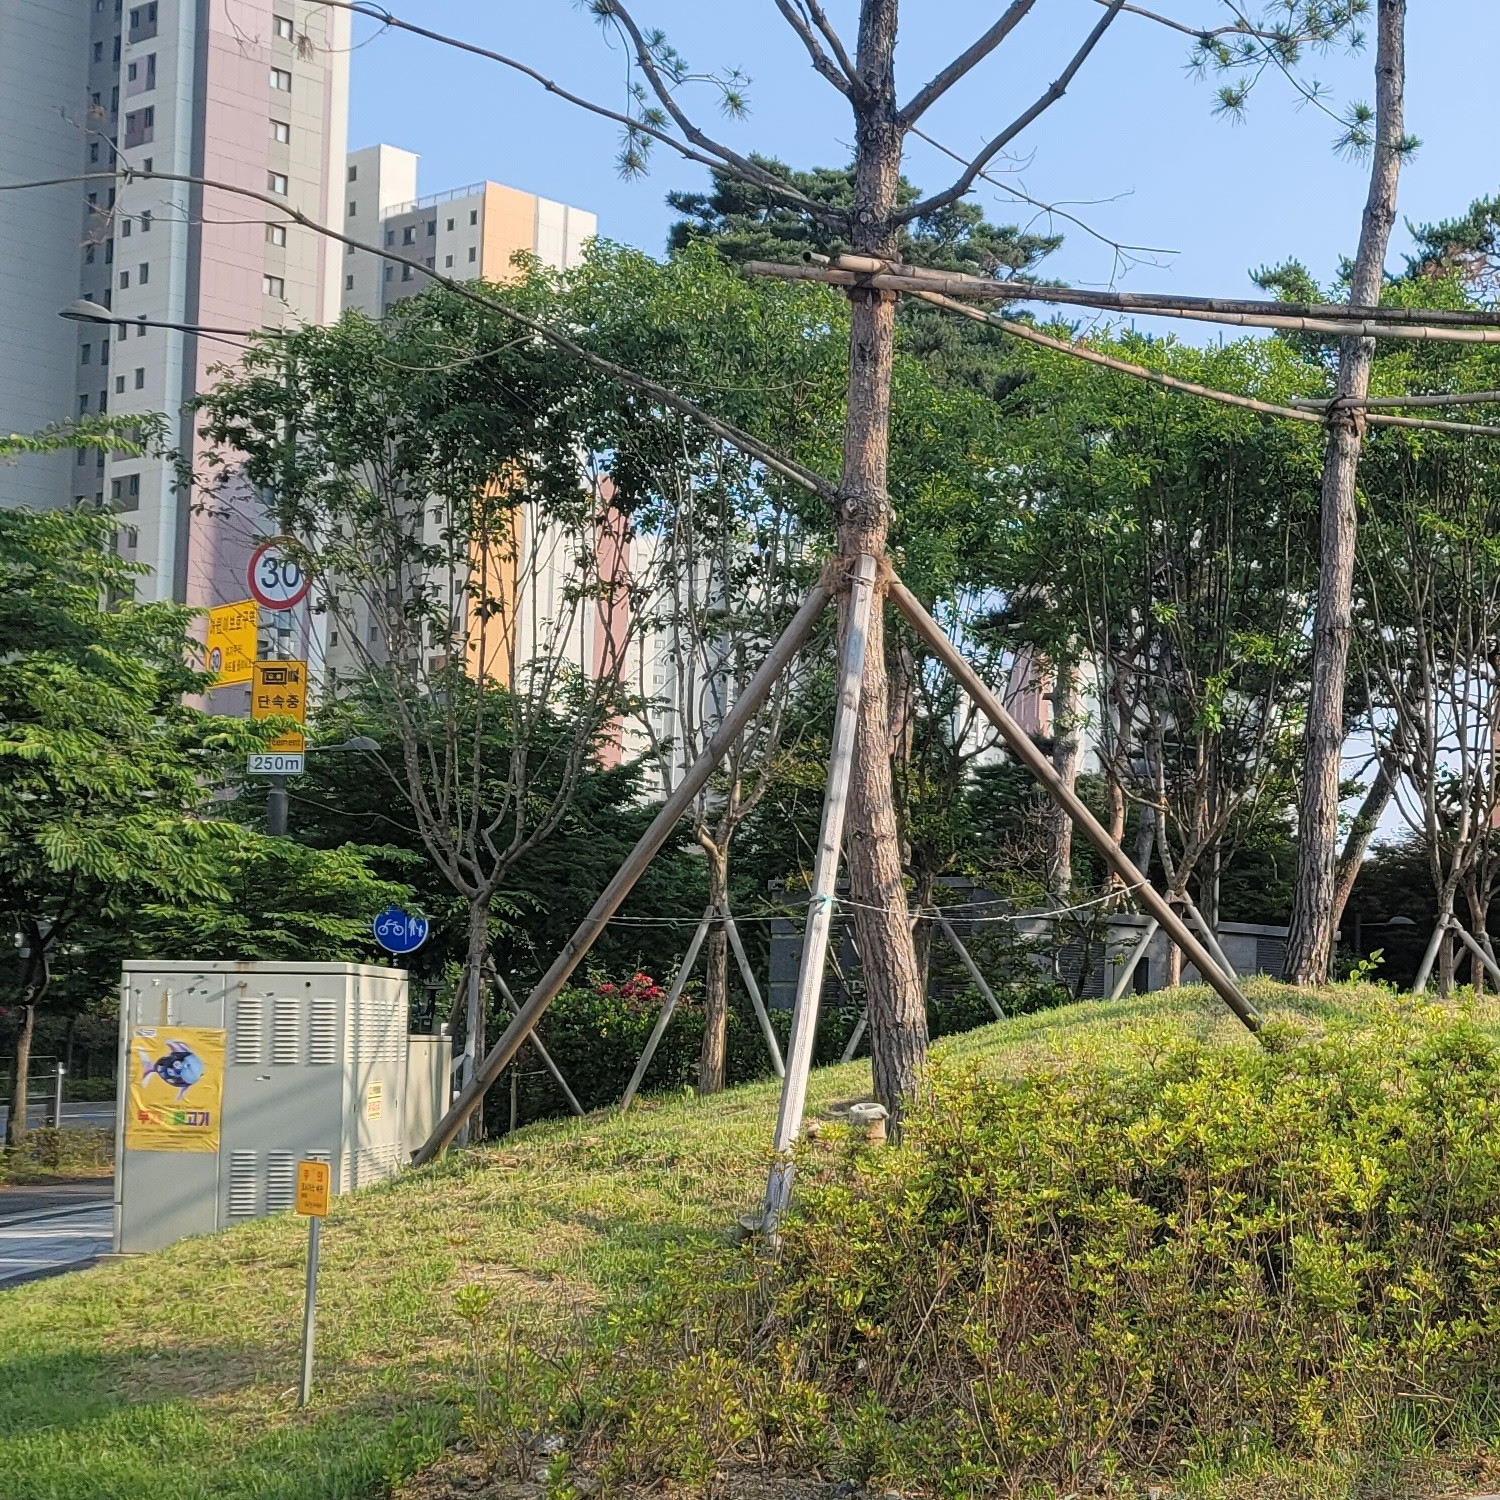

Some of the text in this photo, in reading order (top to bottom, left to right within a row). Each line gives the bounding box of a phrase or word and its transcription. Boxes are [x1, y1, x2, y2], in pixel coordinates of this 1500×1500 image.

[261, 556, 300, 588] 30
[257, 694, 300, 710] 단속중
[253, 756, 300, 771] 250m
